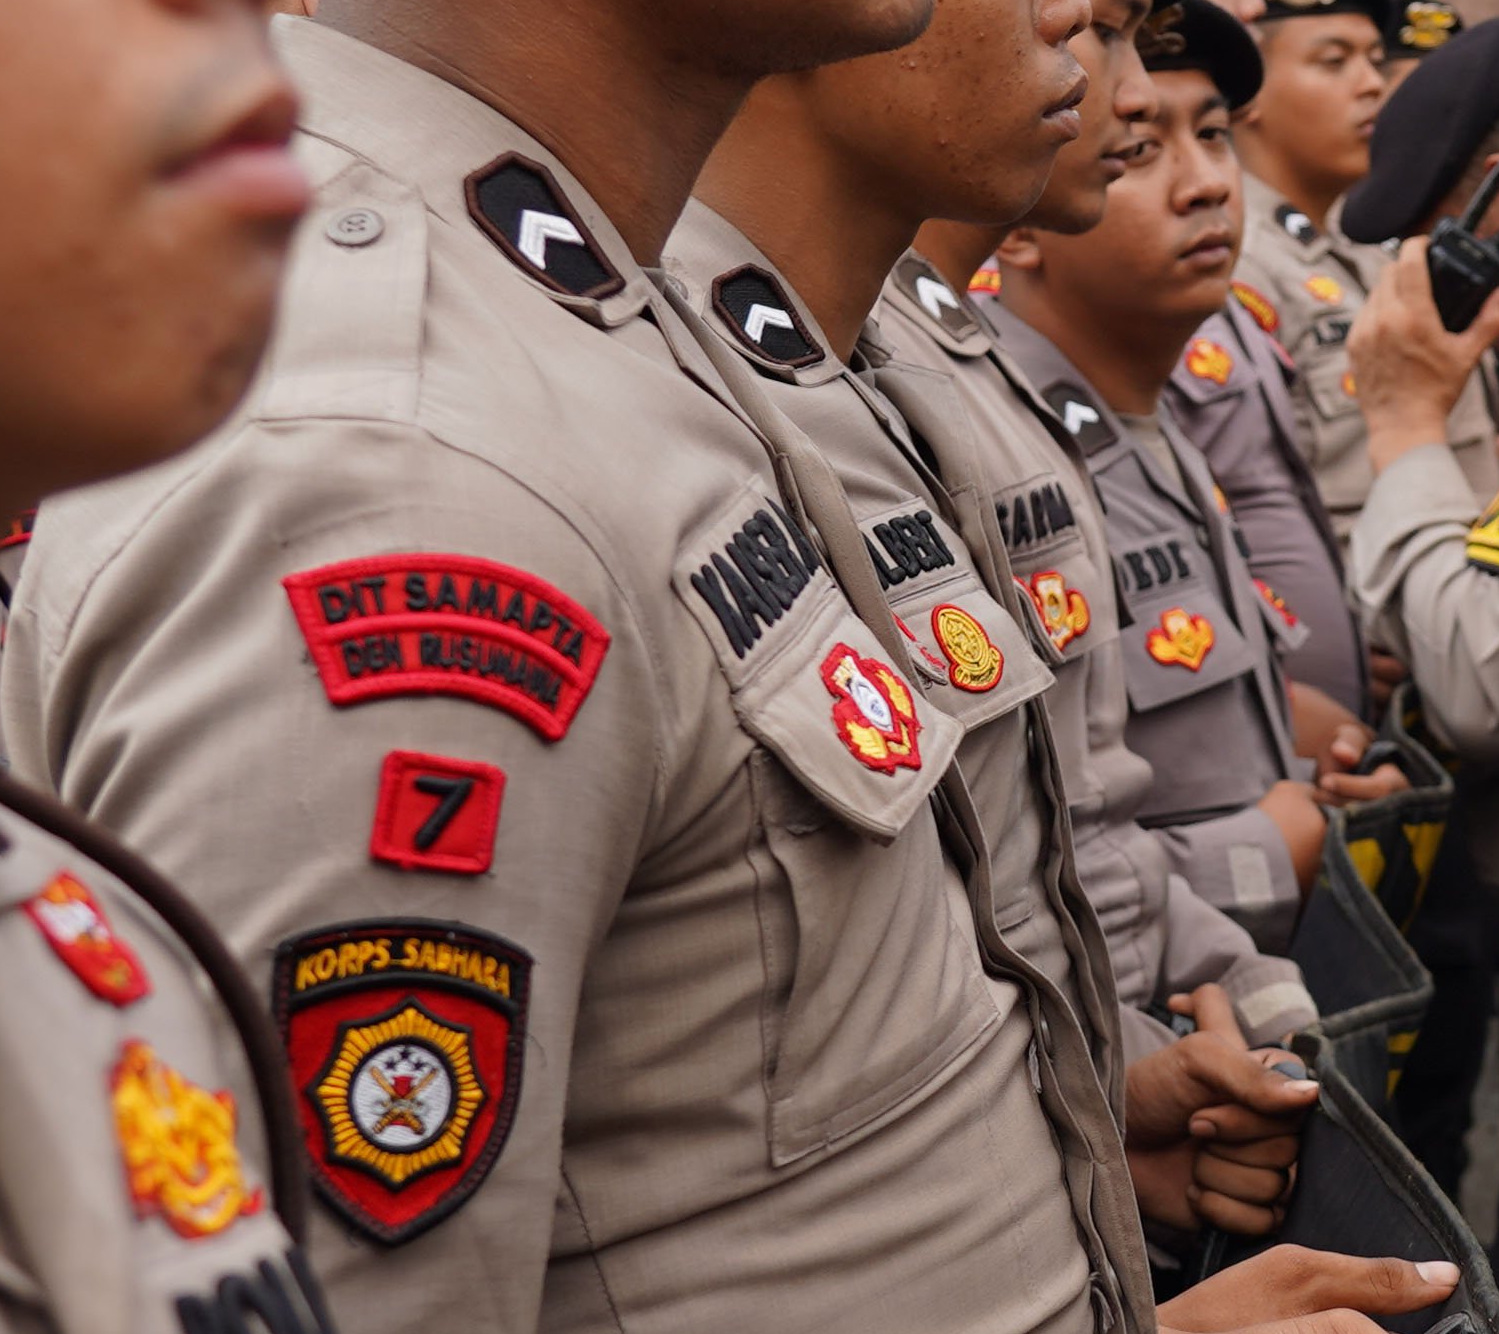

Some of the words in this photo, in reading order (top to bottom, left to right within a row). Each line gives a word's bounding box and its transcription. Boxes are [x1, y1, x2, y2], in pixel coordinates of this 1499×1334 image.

[319, 577, 386, 624] DIT
[405, 572, 585, 668] SAMAPTA
[342, 634, 404, 677] DEN
[414, 774, 476, 850] 7
[296, 938, 393, 991] KORPS
[401, 937, 511, 998] SABHARA
